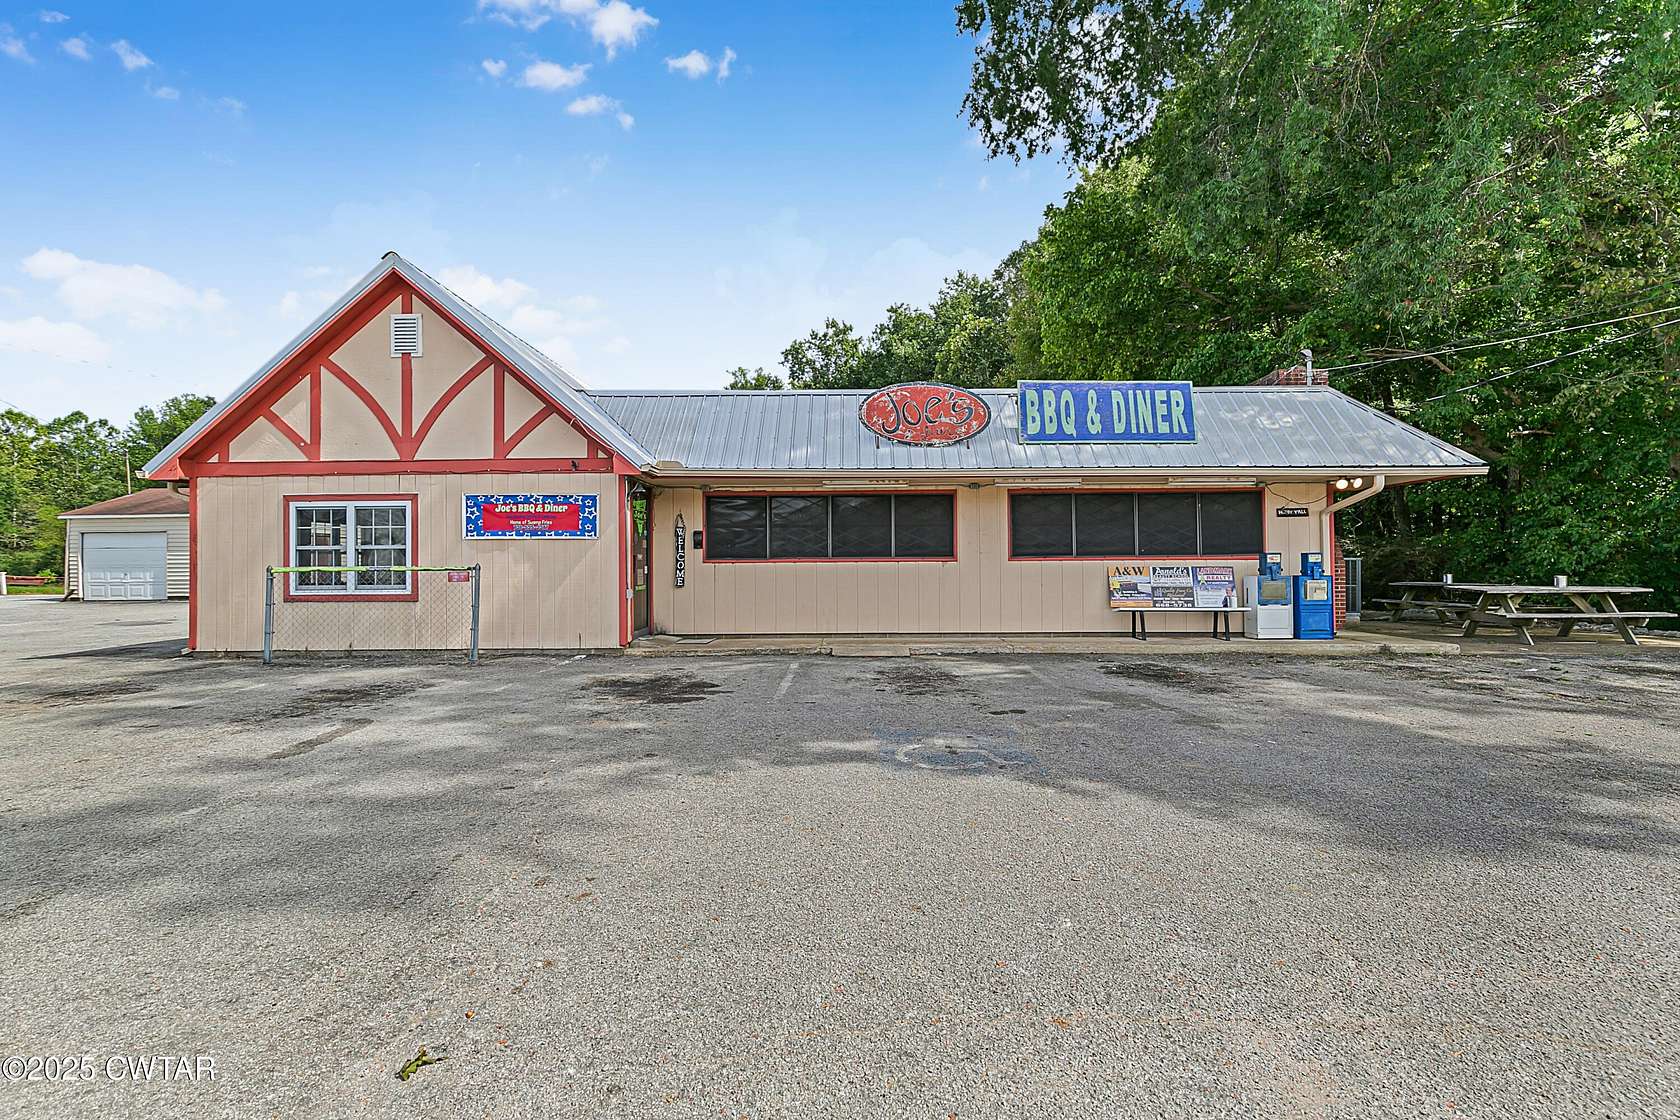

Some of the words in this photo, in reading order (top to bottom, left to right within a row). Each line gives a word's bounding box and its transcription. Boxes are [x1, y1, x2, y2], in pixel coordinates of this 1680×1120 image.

[1026, 389, 1077, 437] BBQ
[1087, 390, 1102, 434] &
[1111, 389, 1188, 435] DINER
[495, 503, 517, 513] Joe's
[518, 503, 535, 514] BBQ
[536, 503, 544, 513] &
[544, 503, 568, 513] Diner
[676, 528, 685, 586] WELCOME
[1113, 566, 1145, 576] A&W
